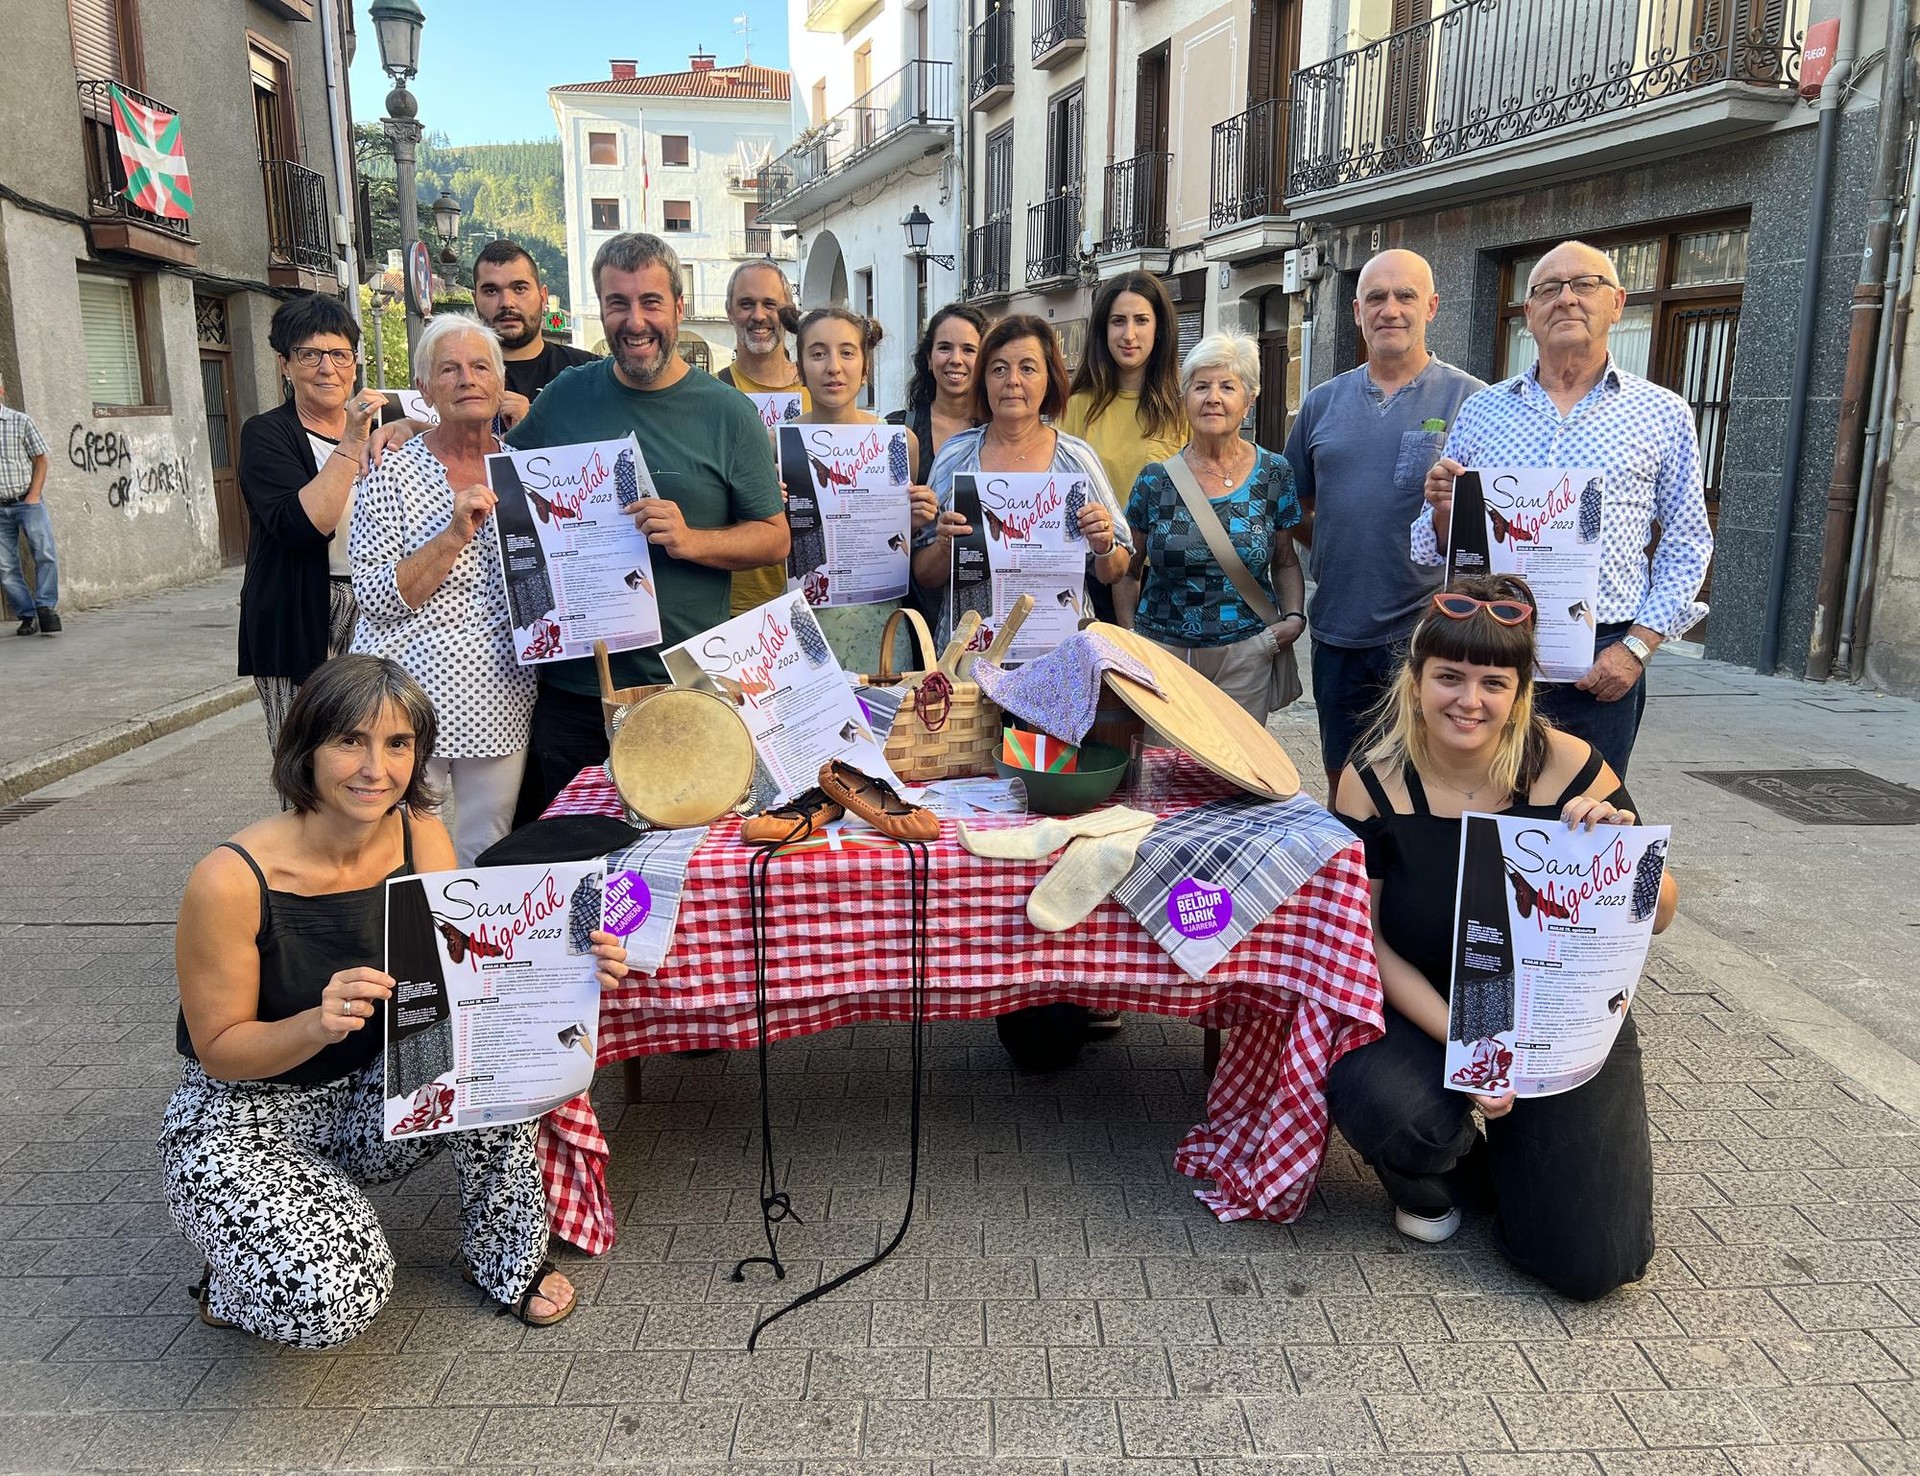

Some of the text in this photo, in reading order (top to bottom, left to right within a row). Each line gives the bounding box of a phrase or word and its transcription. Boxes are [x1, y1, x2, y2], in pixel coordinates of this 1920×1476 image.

[1804, 47, 1827, 61] FUEGO
[1373, 232, 1379, 248] 9
[411, 396, 439, 424] Sa
[69, 422, 131, 473] GREBA
[811, 428, 874, 457] San
[526, 447, 596, 489] San
[829, 432, 884, 496] Migelak
[865, 466, 886, 474] 2023
[549, 452, 610, 531] Migelak
[590, 493, 612, 504] 2023
[986, 476, 1053, 509] San
[1493, 471, 1568, 509] San
[1002, 481, 1062, 549] Migelak
[1039, 520, 1060, 529] 2023
[1508, 477, 1576, 552] Migelak
[1550, 521, 1574, 530] 2023
[703, 607, 767, 673] San
[739, 614, 788, 709] Migelak
[778, 651, 800, 670] 2023
[1514, 829, 1621, 876] San
[442, 868, 550, 921] San
[605, 877, 634, 912] LDUR
[1176, 892, 1222, 913] BELDUR
[1536, 840, 1632, 932] Migelak
[1595, 894, 1626, 906] 2023
[468, 876, 565, 973] Migelak
[604, 894, 637, 927] BARIK
[613, 904, 643, 933] #JARRERA
[1180, 907, 1216, 925] BARIK
[1183, 919, 1218, 933] #JARRERA
[528, 928, 562, 940] 2023
